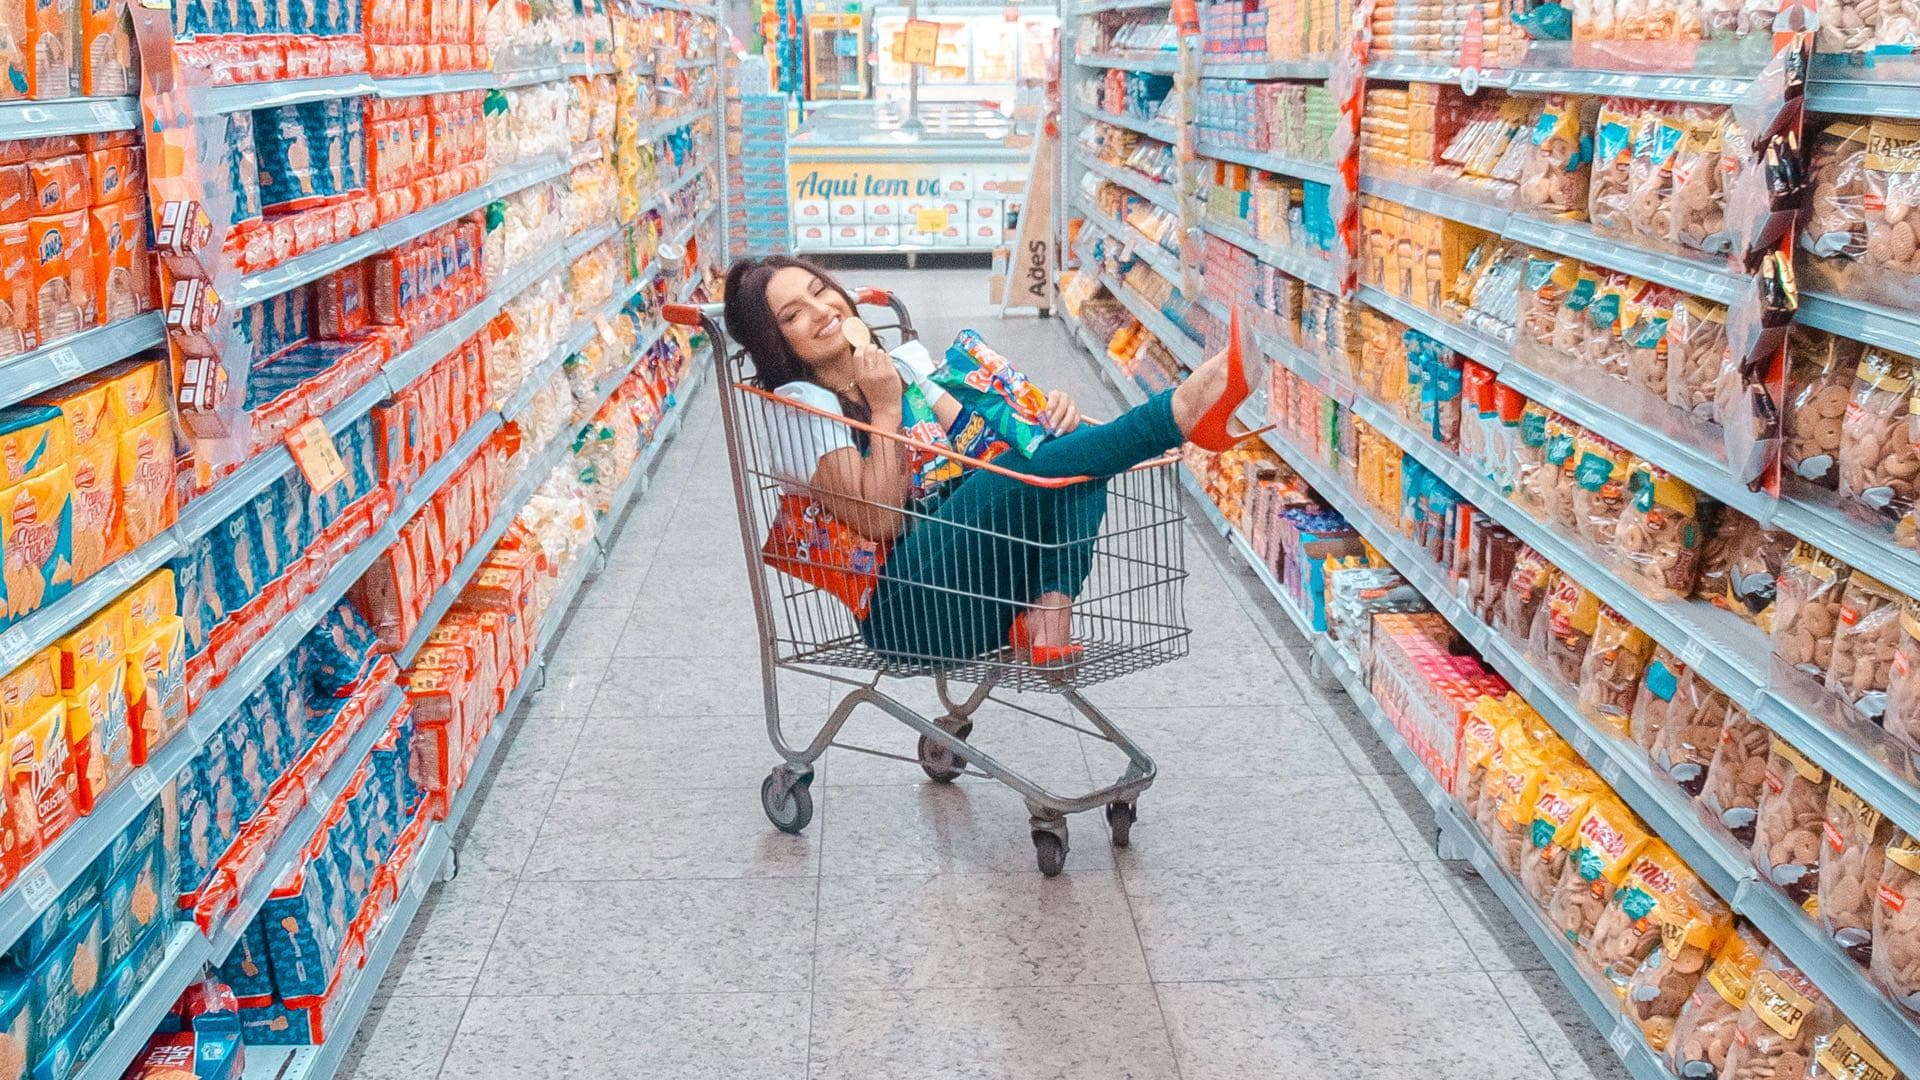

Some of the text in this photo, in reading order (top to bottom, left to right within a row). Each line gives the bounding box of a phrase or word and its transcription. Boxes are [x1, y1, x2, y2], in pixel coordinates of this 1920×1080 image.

[796, 171, 858, 199] Aqui
[864, 175, 909, 197] tem
[1028, 240, 1047, 297] AdeS
[146, 1045, 170, 1066] PLUS
[170, 1045, 194, 1066] SALT
